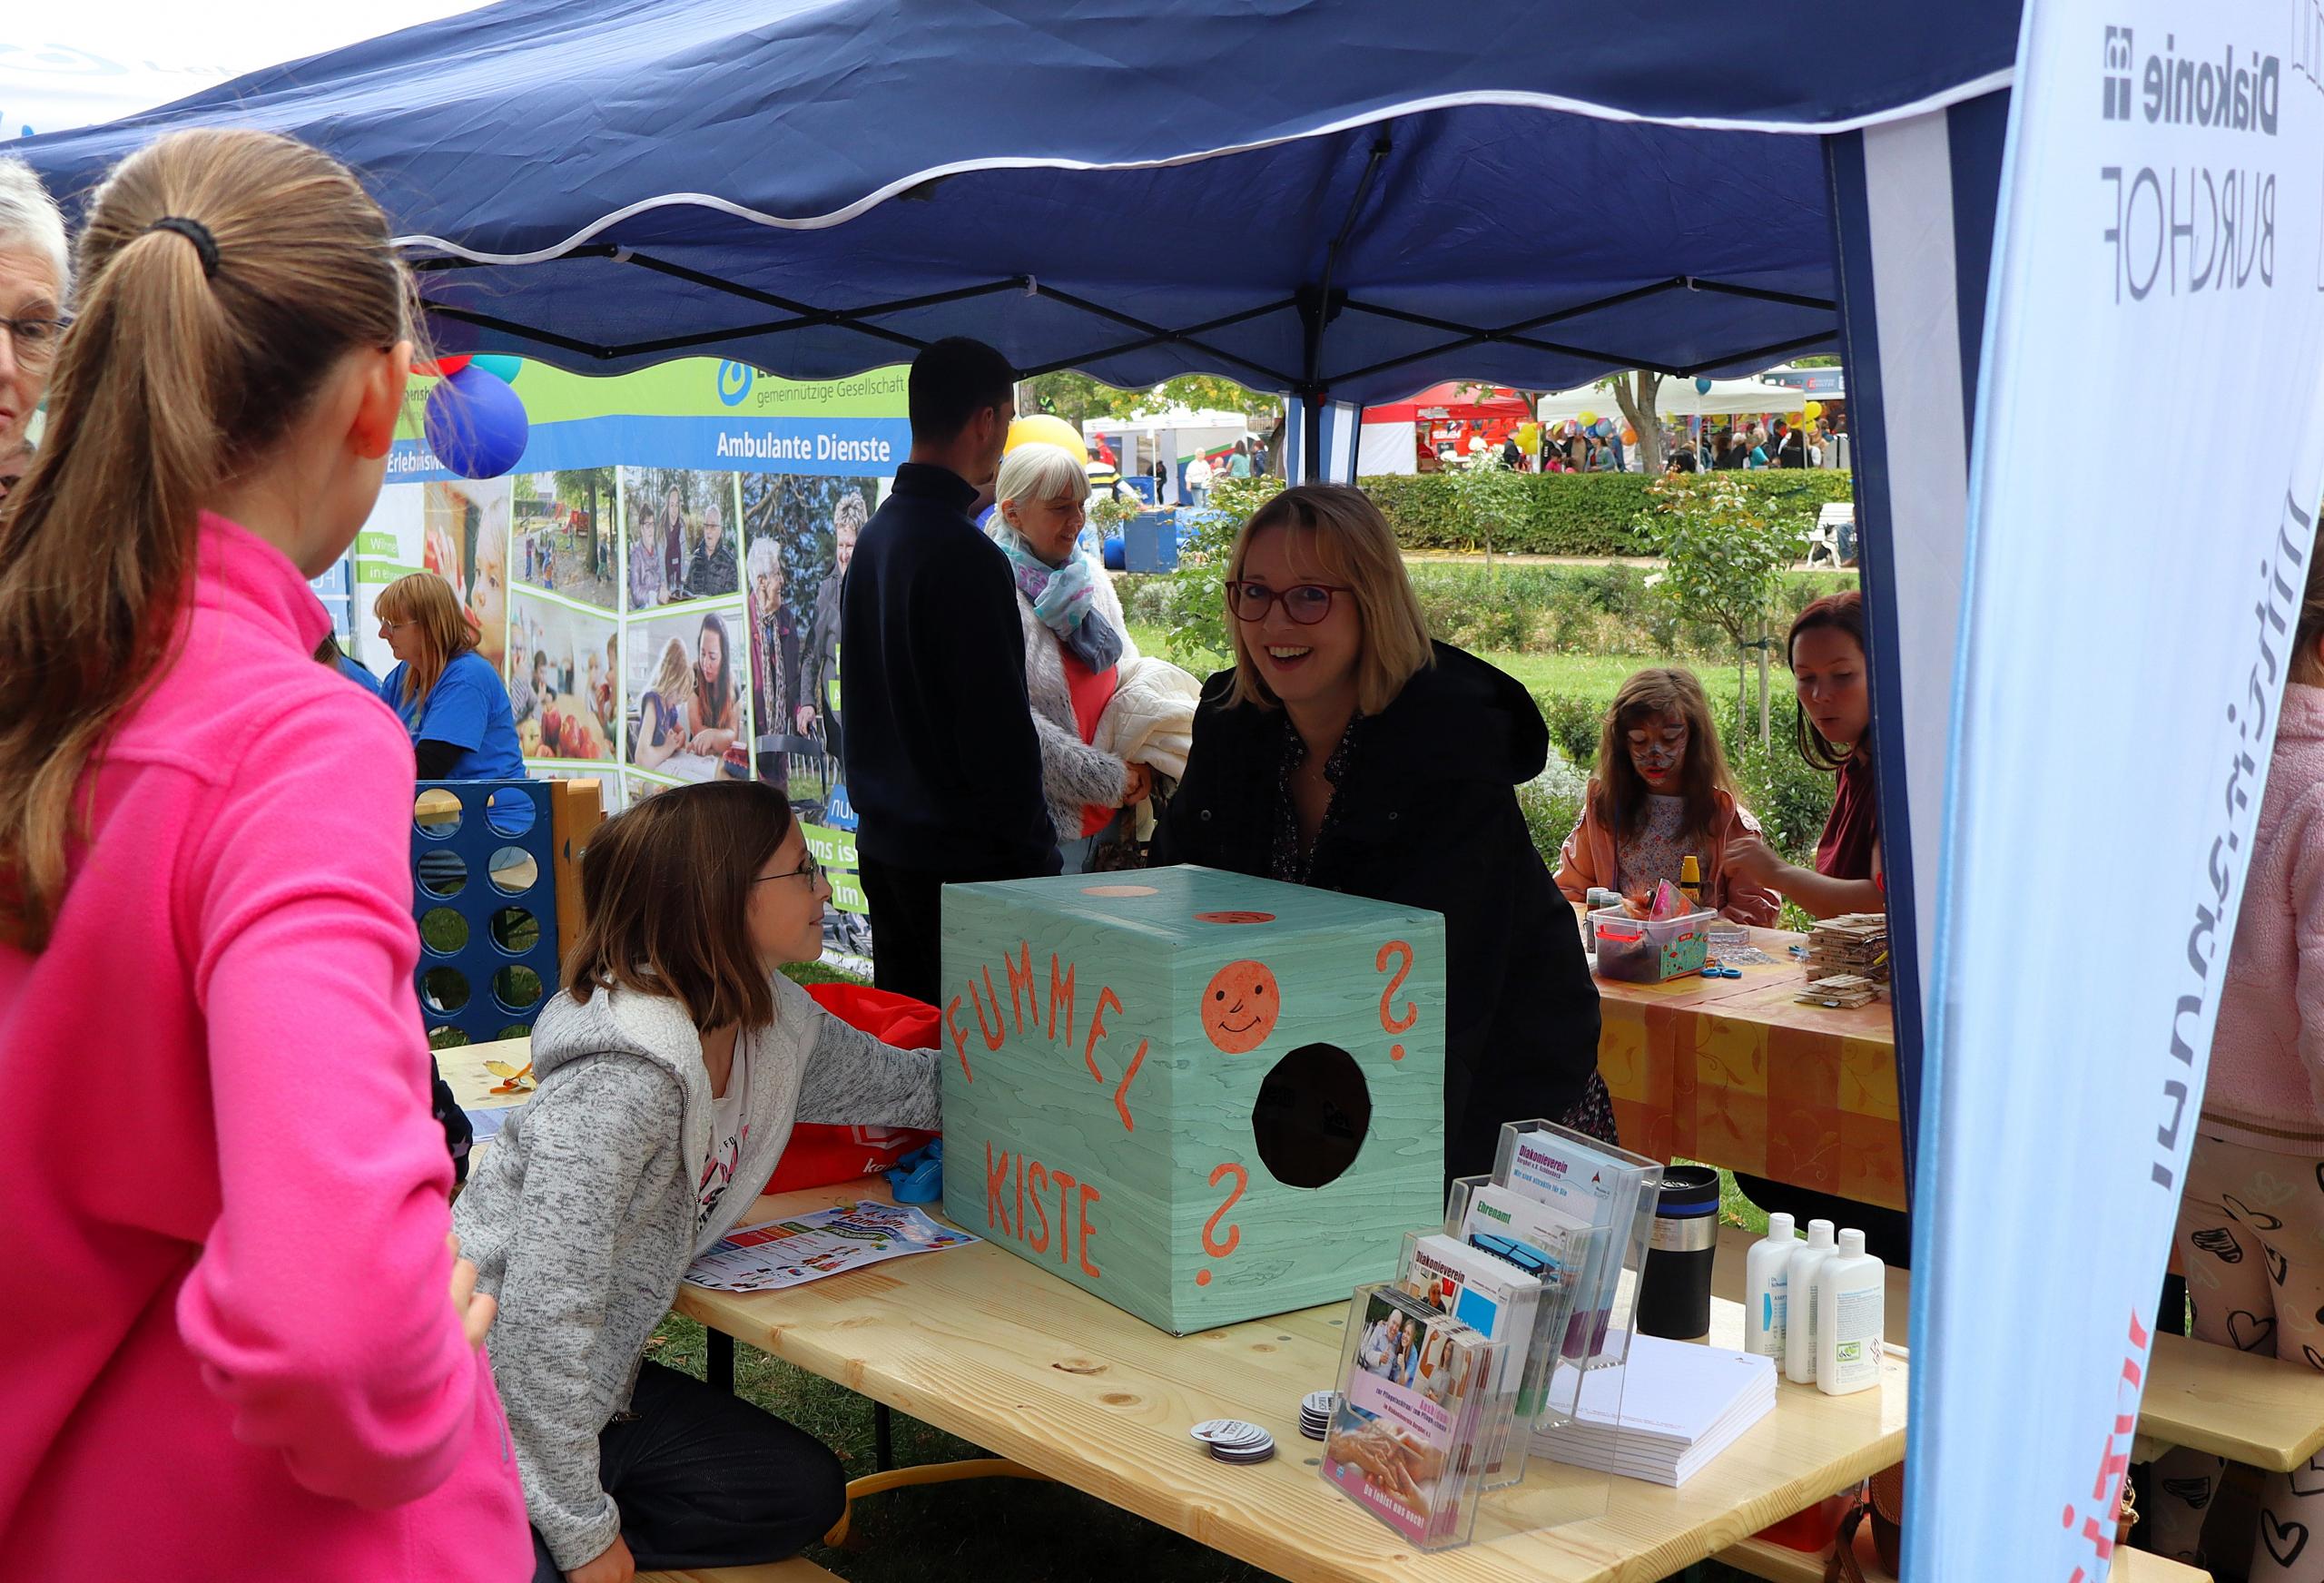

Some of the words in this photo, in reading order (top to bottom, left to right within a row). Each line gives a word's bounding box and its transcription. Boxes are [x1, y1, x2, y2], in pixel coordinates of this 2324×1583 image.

[756, 384, 833, 408] gemeinnützige
[836, 374, 905, 398] Gesellschaft
[716, 431, 812, 460] Ambulante
[817, 433, 891, 463] Dienste
[945, 939, 1148, 1132] FUMMEL
[1519, 1145, 1568, 1174] Diakonieverein
[985, 1138, 1100, 1279] KISTE
[1477, 1199, 1512, 1224] Ehrenamt
[1415, 1250, 1465, 1284] Diakonieverein
